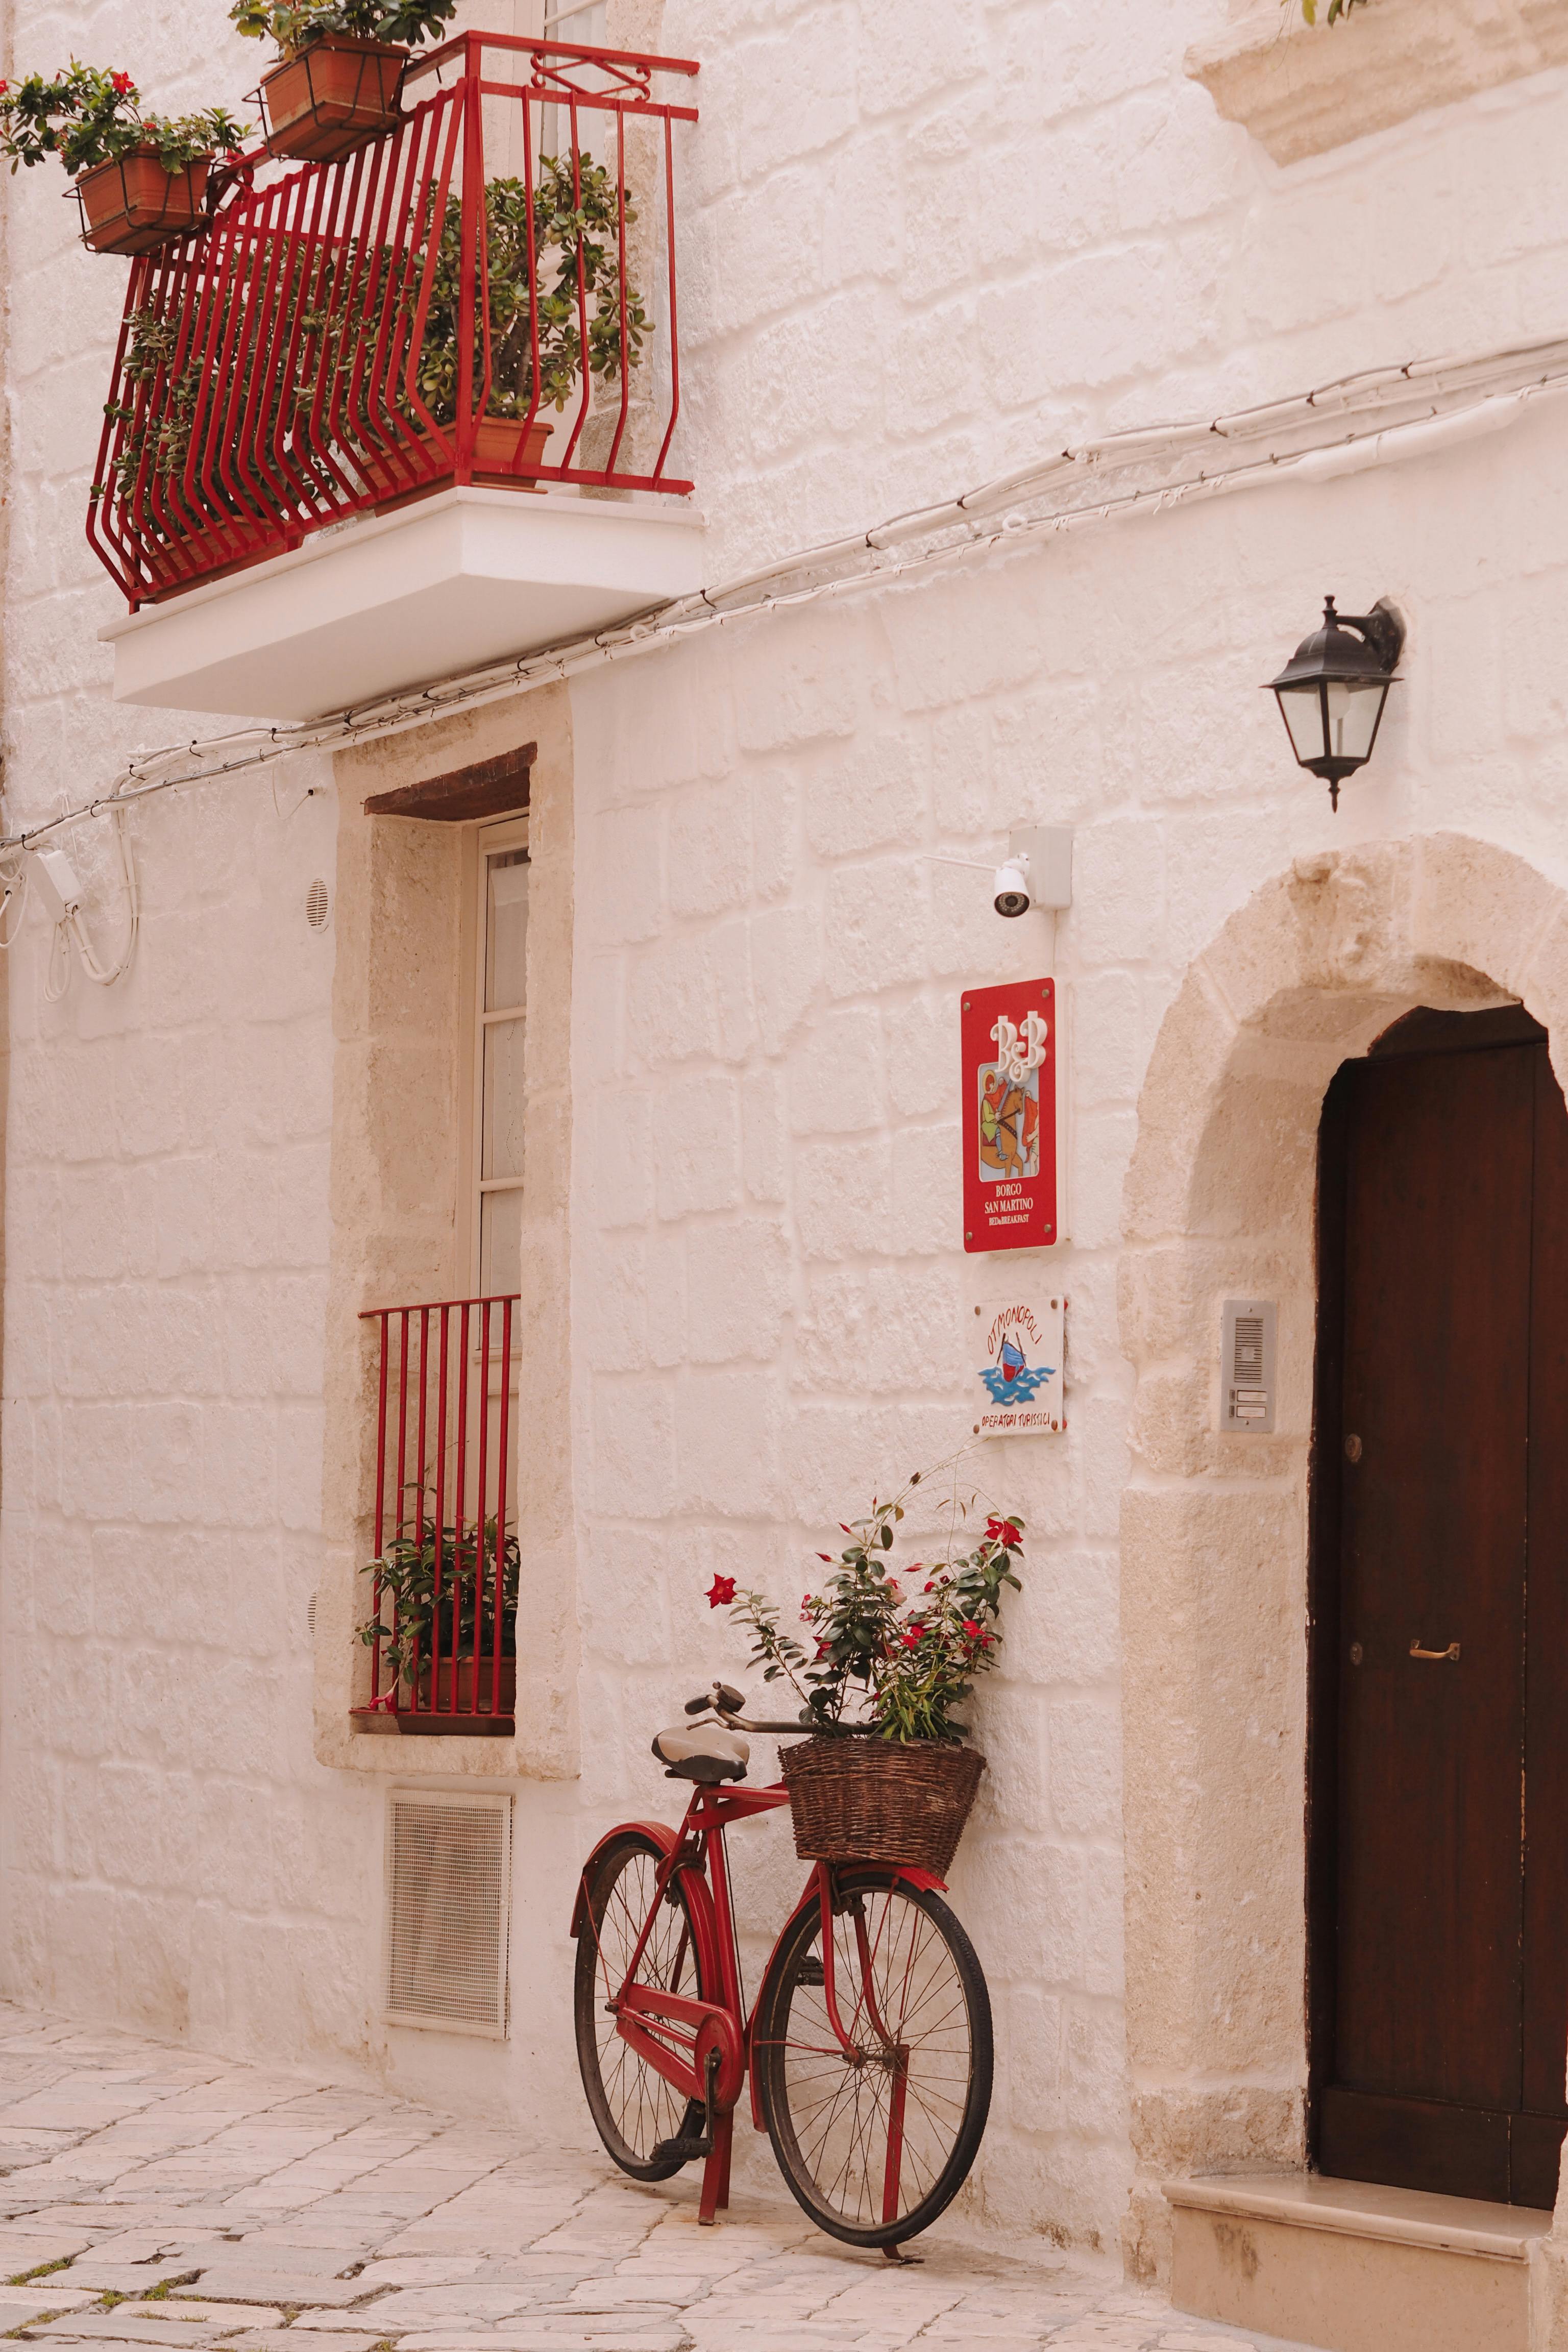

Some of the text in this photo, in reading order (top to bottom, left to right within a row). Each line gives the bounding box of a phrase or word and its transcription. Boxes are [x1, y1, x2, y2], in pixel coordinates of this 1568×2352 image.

[990, 1011, 1048, 1083] B&B
[996, 1183, 1022, 1197] BORGO
[985, 1197, 1034, 1214] SAN MARTINO
[982, 1413, 1017, 1428] OPERATORI
